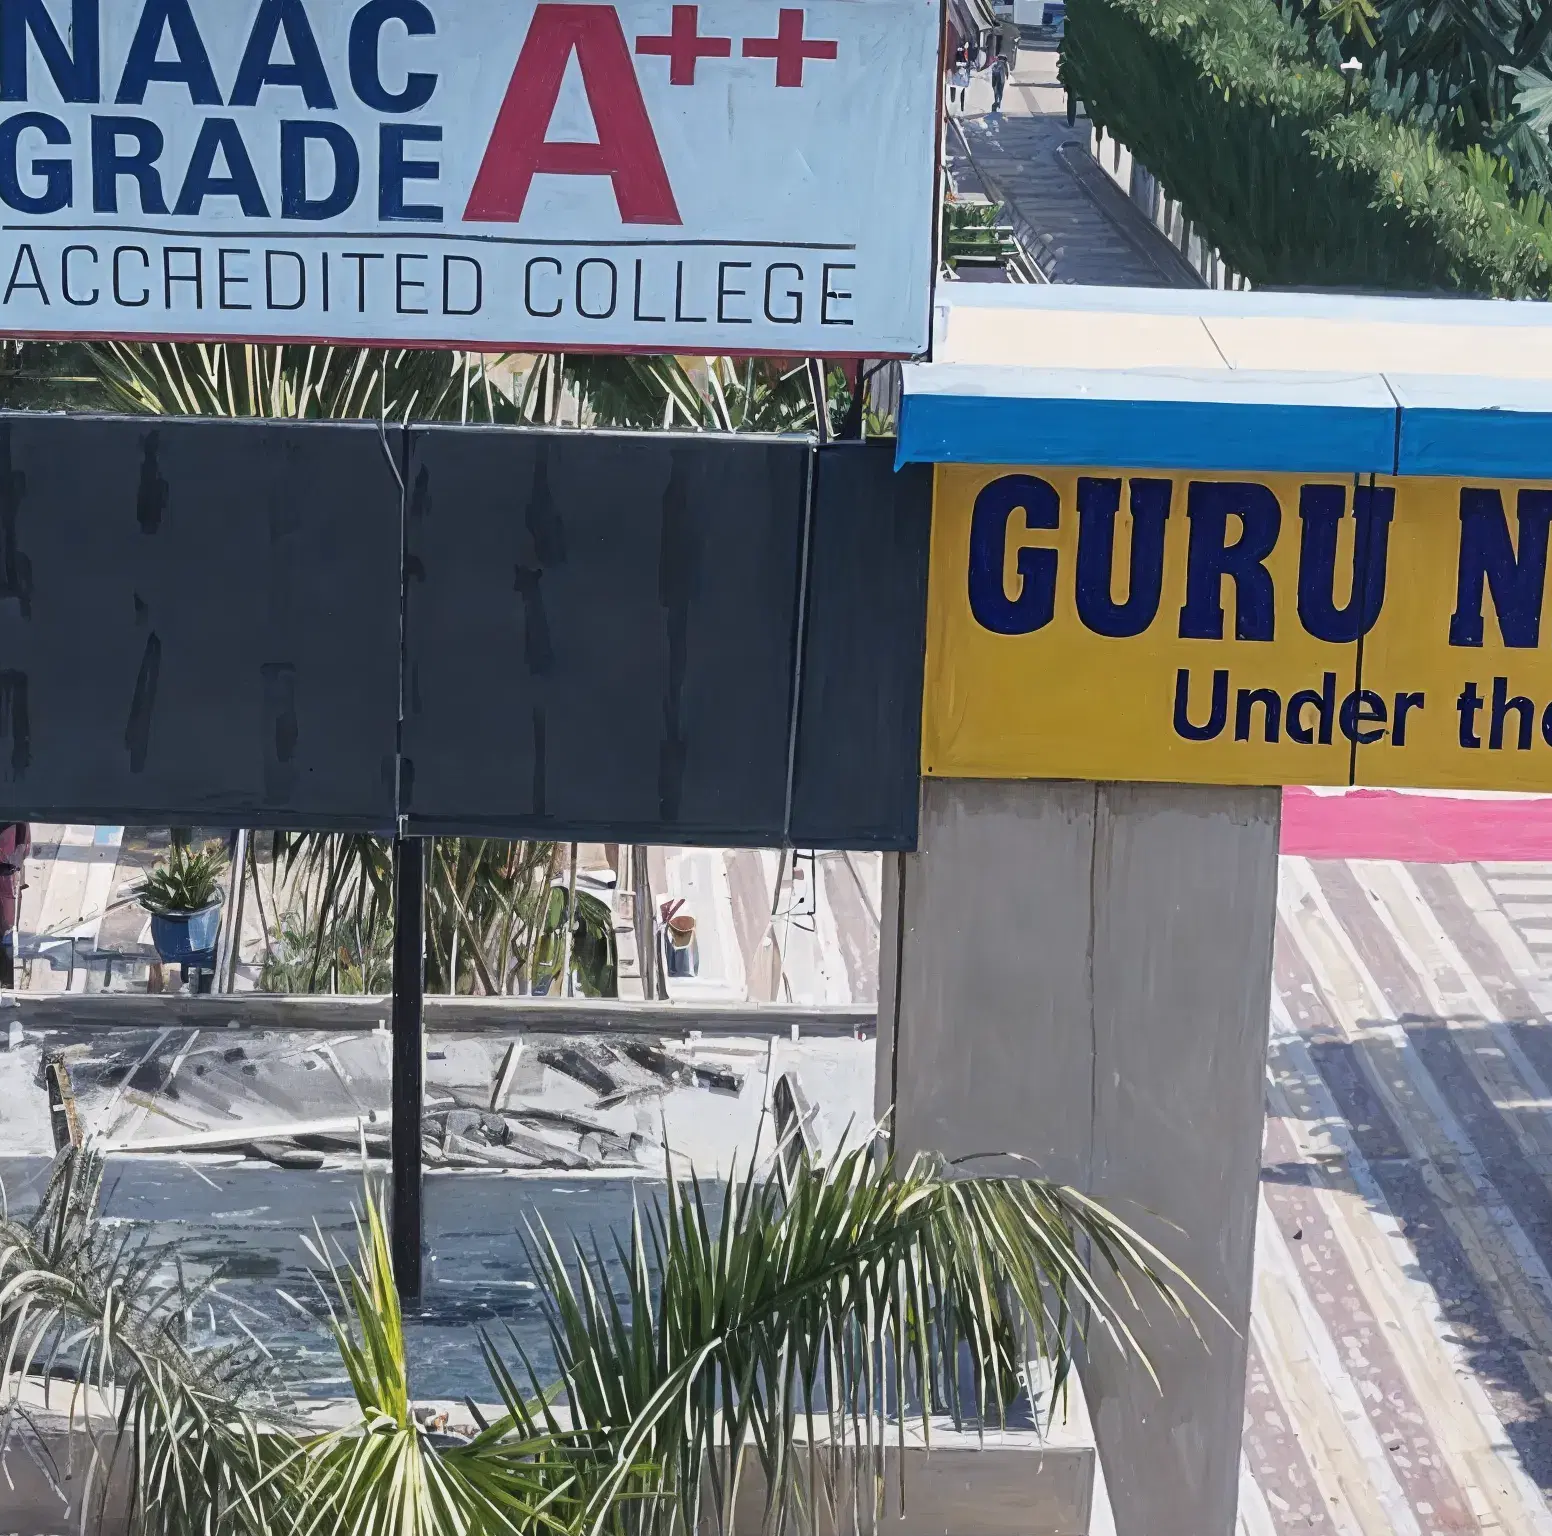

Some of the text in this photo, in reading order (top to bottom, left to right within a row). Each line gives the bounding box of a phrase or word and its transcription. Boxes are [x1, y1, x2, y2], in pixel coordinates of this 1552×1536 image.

[2, 243, 856, 326] ACCREDITED COLLEGE
[967, 473, 1395, 642] GURU
[1173, 668, 1425, 747] Under
